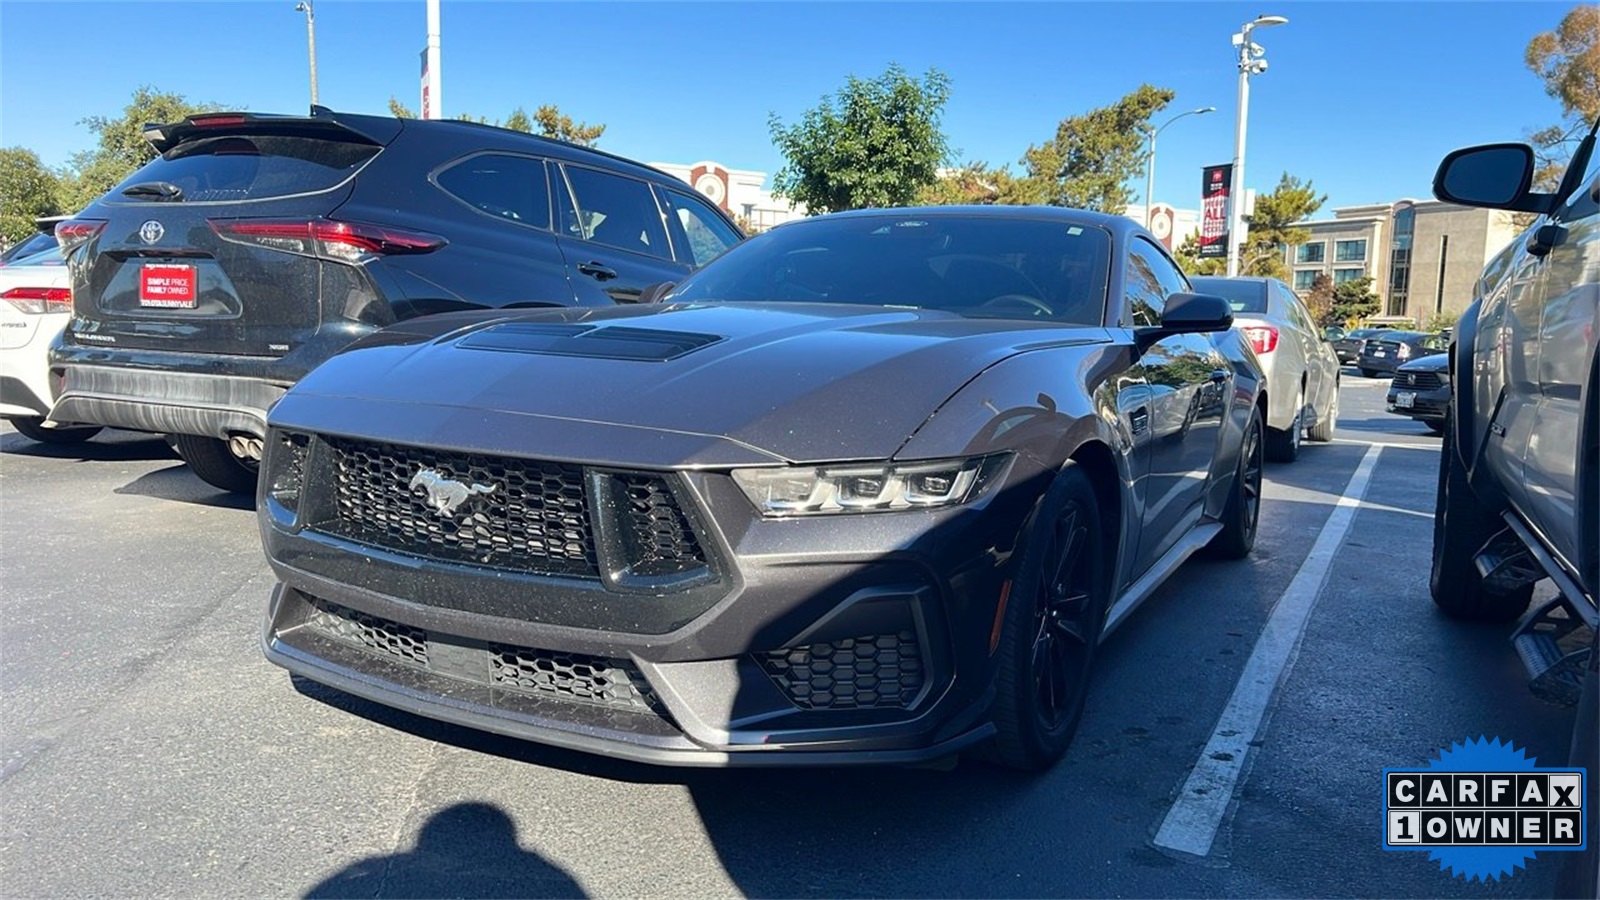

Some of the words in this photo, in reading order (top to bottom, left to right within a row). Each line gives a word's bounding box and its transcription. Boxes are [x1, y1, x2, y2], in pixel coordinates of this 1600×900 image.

[1205, 208, 1226, 219] ALL
[147, 277, 170, 285] SIMPLE
[147, 286, 166, 294] FAMILY
